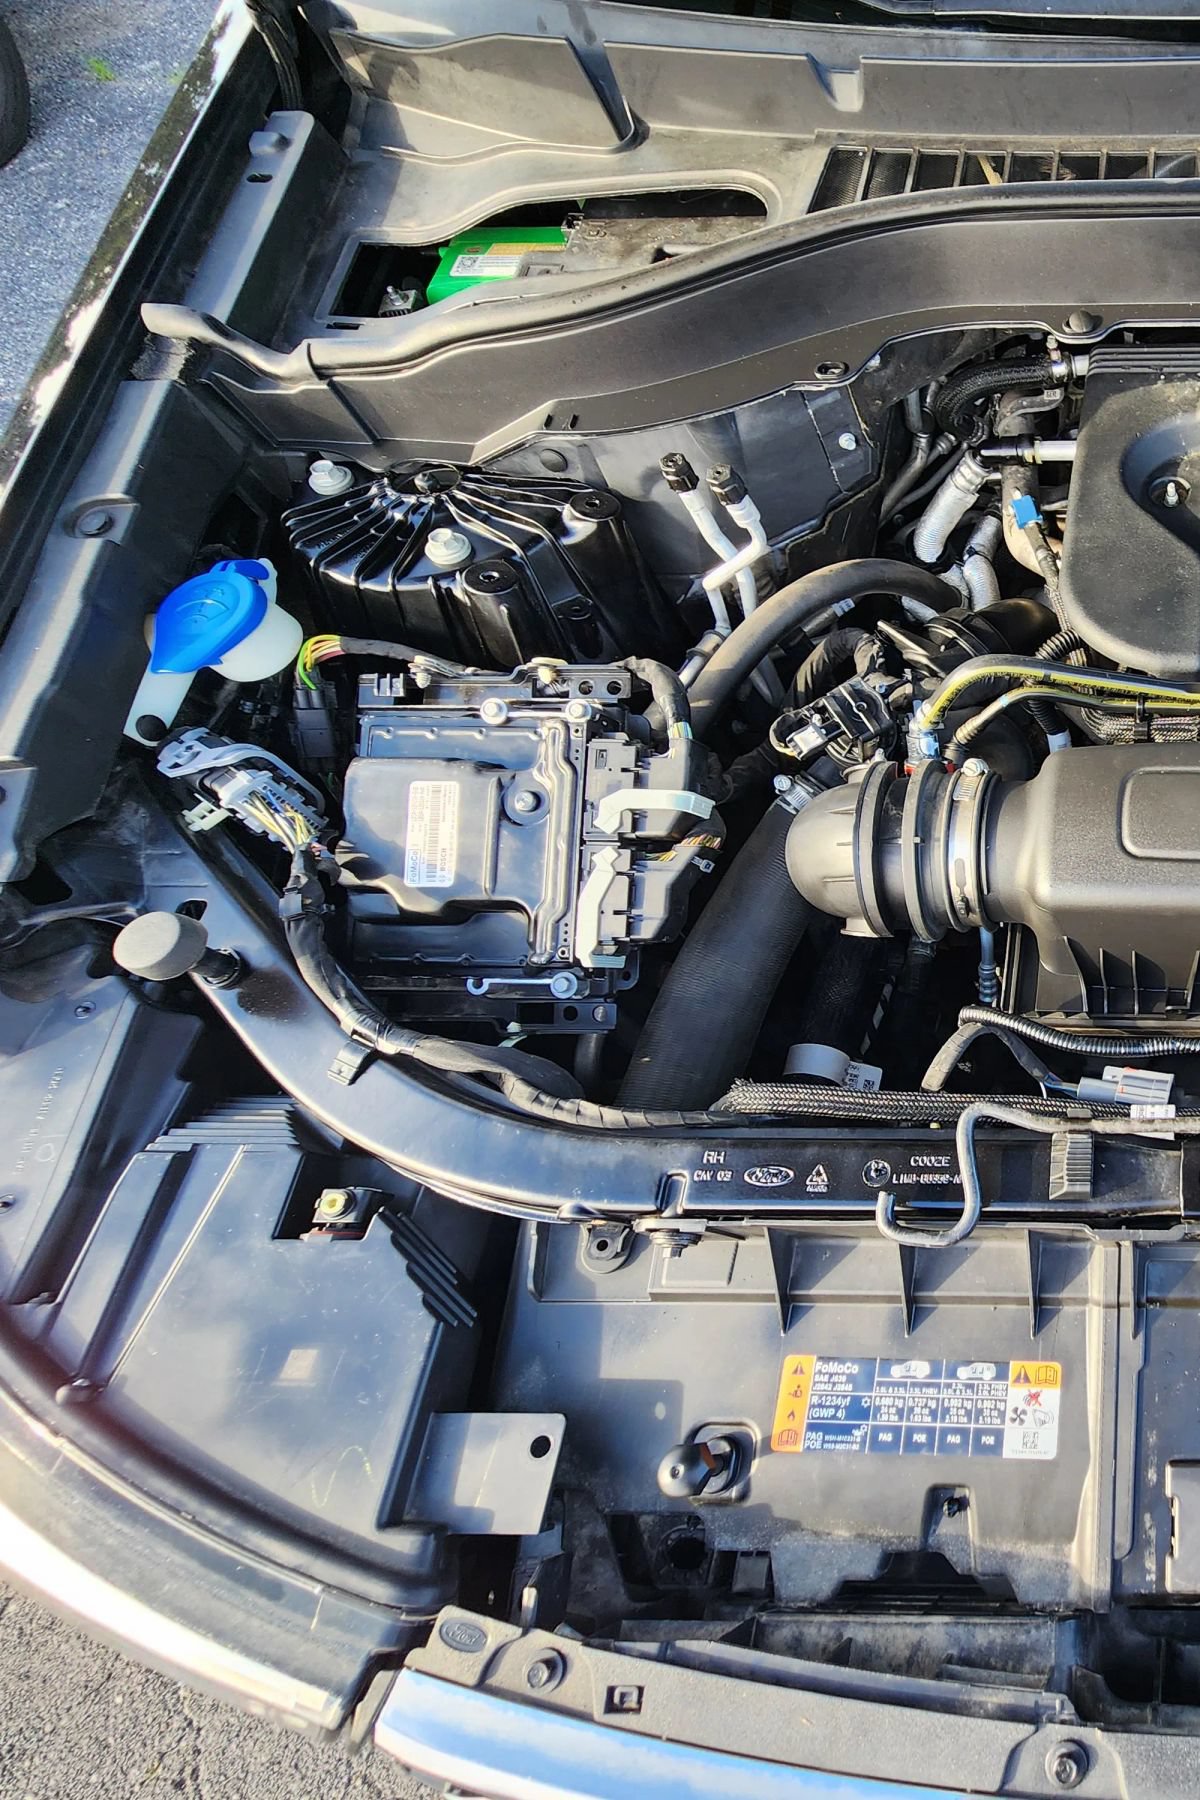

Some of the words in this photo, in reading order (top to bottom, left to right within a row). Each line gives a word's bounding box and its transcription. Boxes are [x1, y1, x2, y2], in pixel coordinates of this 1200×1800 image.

[409, 850, 419, 883] FoMoCo
[702, 1150, 725, 1164] RH
[815, 1361, 859, 1374] FoMoCo
[814, 1374, 830, 1382] SAE
[810, 1395, 851, 1407] R-1234yf
[894, 1398, 903, 1408] kg
[927, 1399, 936, 1409] kg
[963, 1399, 972, 1410] kg
[996, 1400, 1006, 1411] kg
[809, 1407, 835, 1419] (GWP
[836, 1408, 846, 1420] 4)
[805, 1431, 823, 1440] PAG
[878, 1432, 893, 1442] PAG
[912, 1433, 927, 1443] POE
[946, 1434, 961, 1444] PAG
[981, 1435, 995, 1445] POE
[804, 1440, 823, 1449] POE
